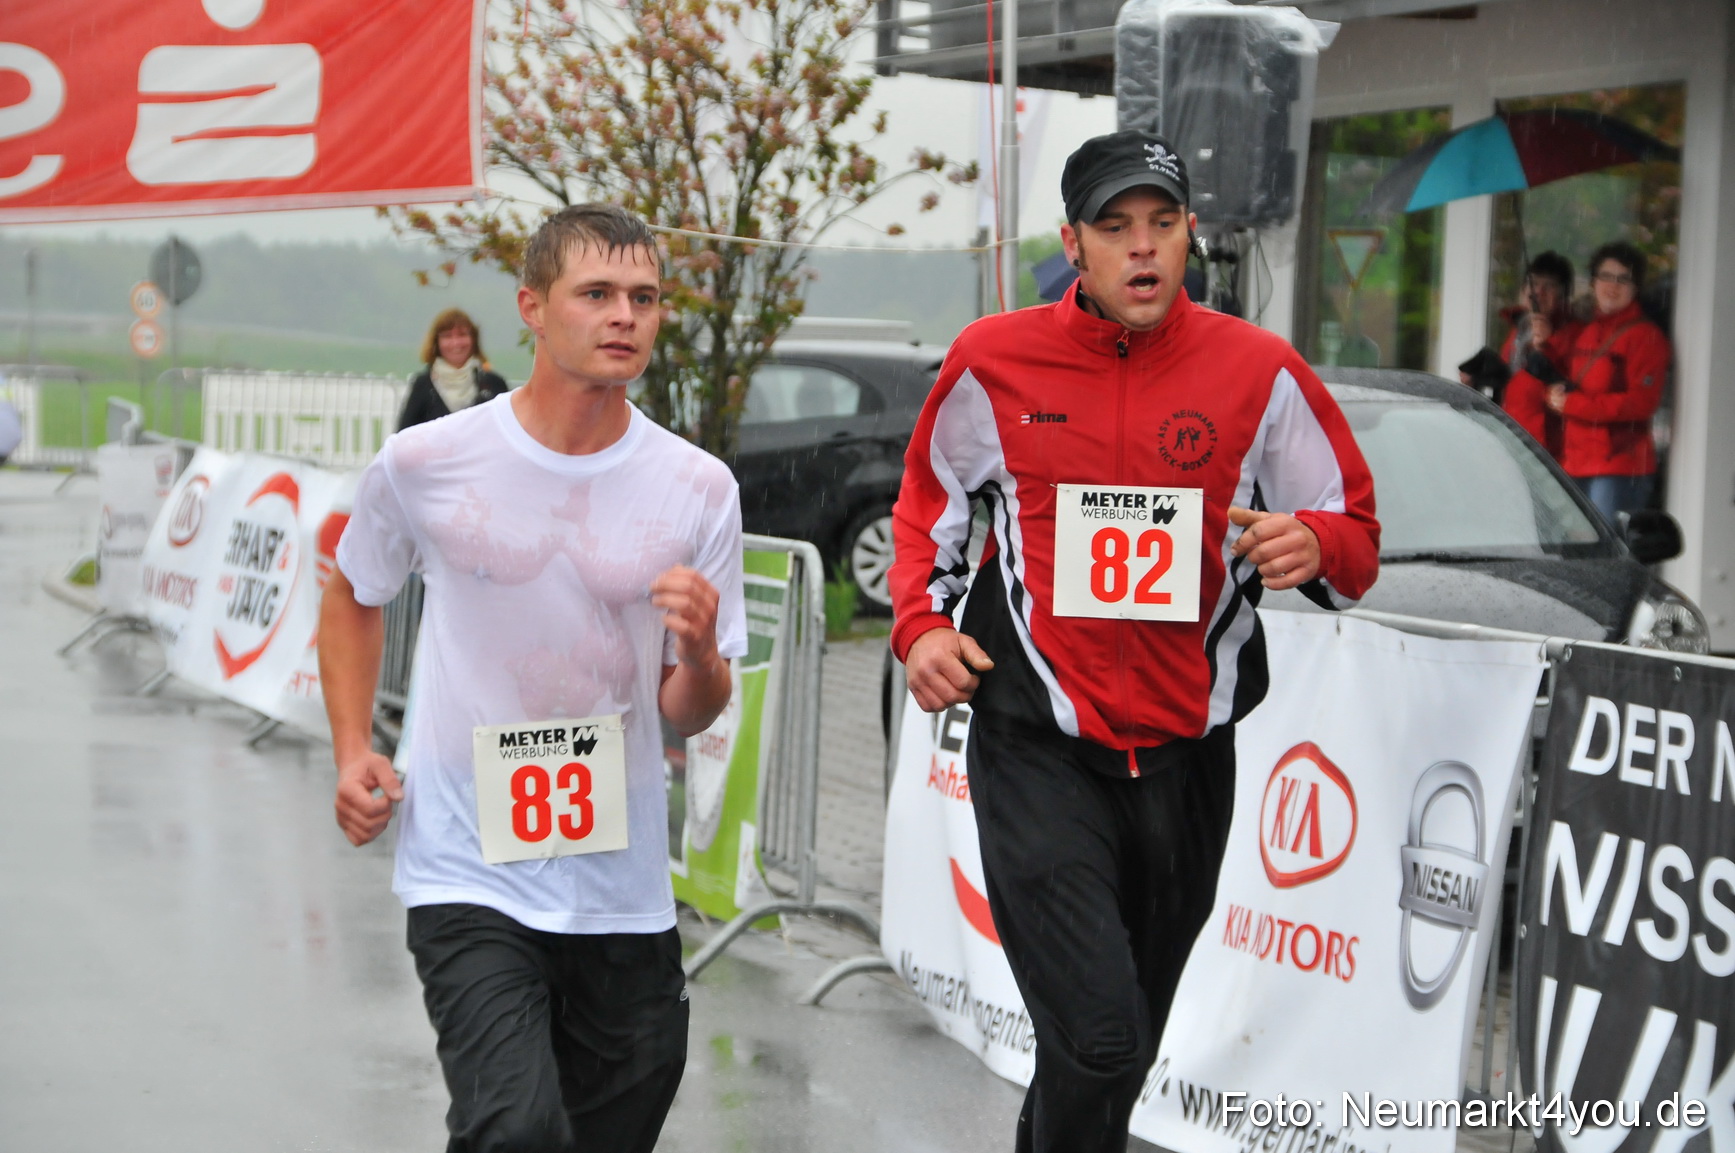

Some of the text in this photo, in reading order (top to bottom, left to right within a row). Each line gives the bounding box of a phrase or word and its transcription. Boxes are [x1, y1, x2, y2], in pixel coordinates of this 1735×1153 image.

[1172, 409, 1218, 443] NEUMARKT
[1081, 491, 1147, 508] MEYER
[1081, 507, 1147, 521] WERBUNG
[1090, 527, 1174, 605] 82
[499, 728, 566, 748] MEYER
[500, 744, 569, 760] WERBUNG
[1569, 695, 1694, 795] DER
[510, 762, 594, 843] 83
[1269, 776, 1324, 859] KIA
[1410, 861, 1481, 915] NISSAN
[1222, 903, 1250, 950] KIA
